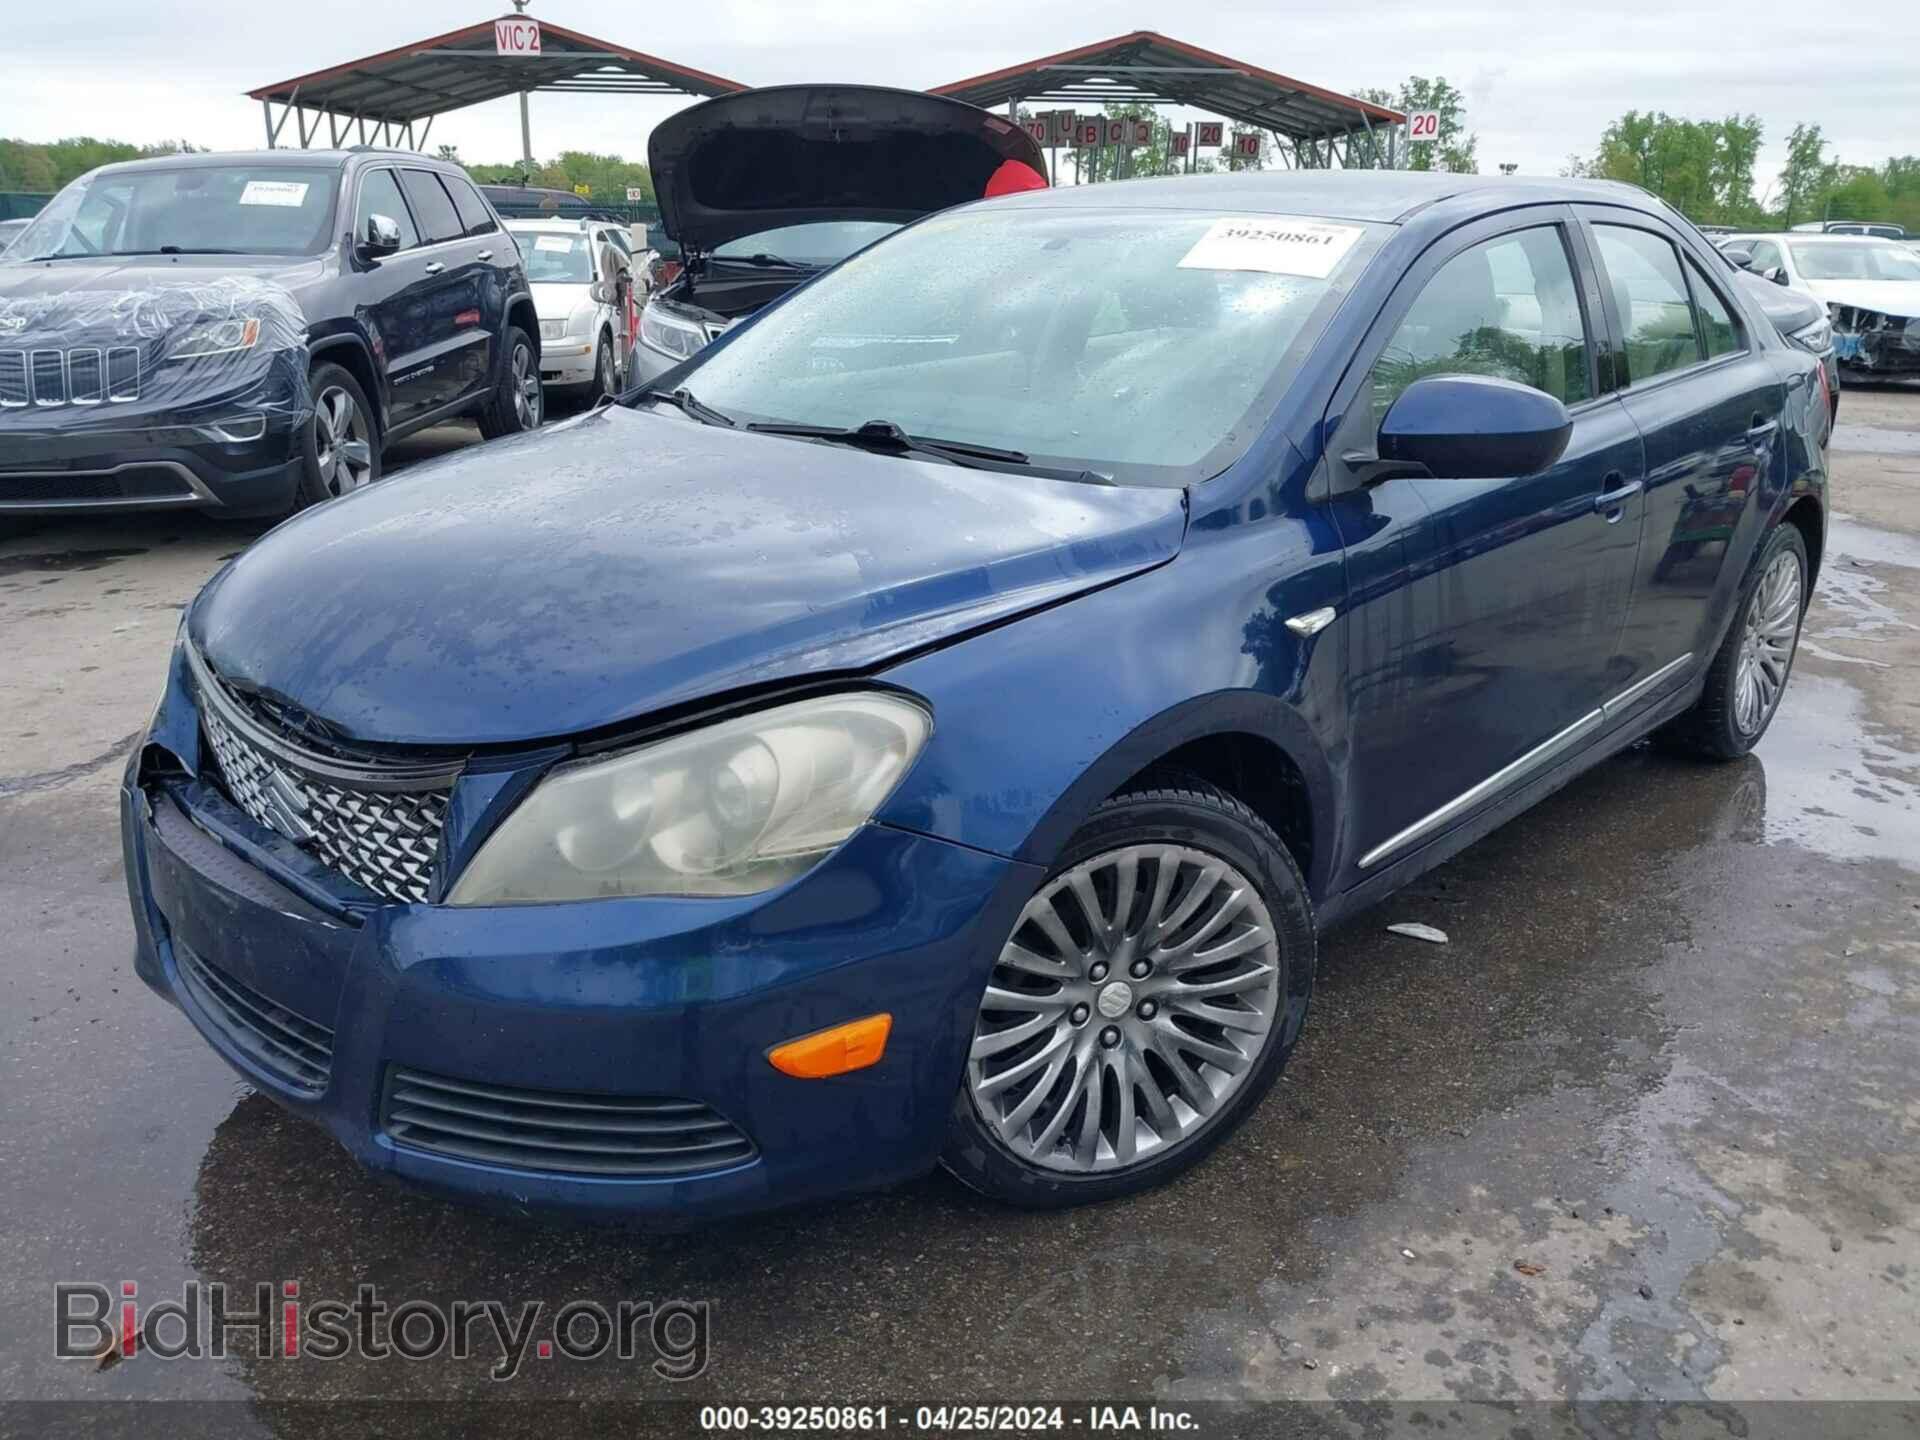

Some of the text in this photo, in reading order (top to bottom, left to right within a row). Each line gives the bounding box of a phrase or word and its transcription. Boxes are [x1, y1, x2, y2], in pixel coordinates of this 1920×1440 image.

[497, 25, 539, 50] VIC 2
[1412, 115, 1437, 135] 20
[1086, 127, 1097, 143] B
[1200, 127, 1221, 143] 20
[1175, 137, 1188, 153] 10
[1240, 138, 1257, 154] 10
[1220, 228, 1335, 246] 39250861
